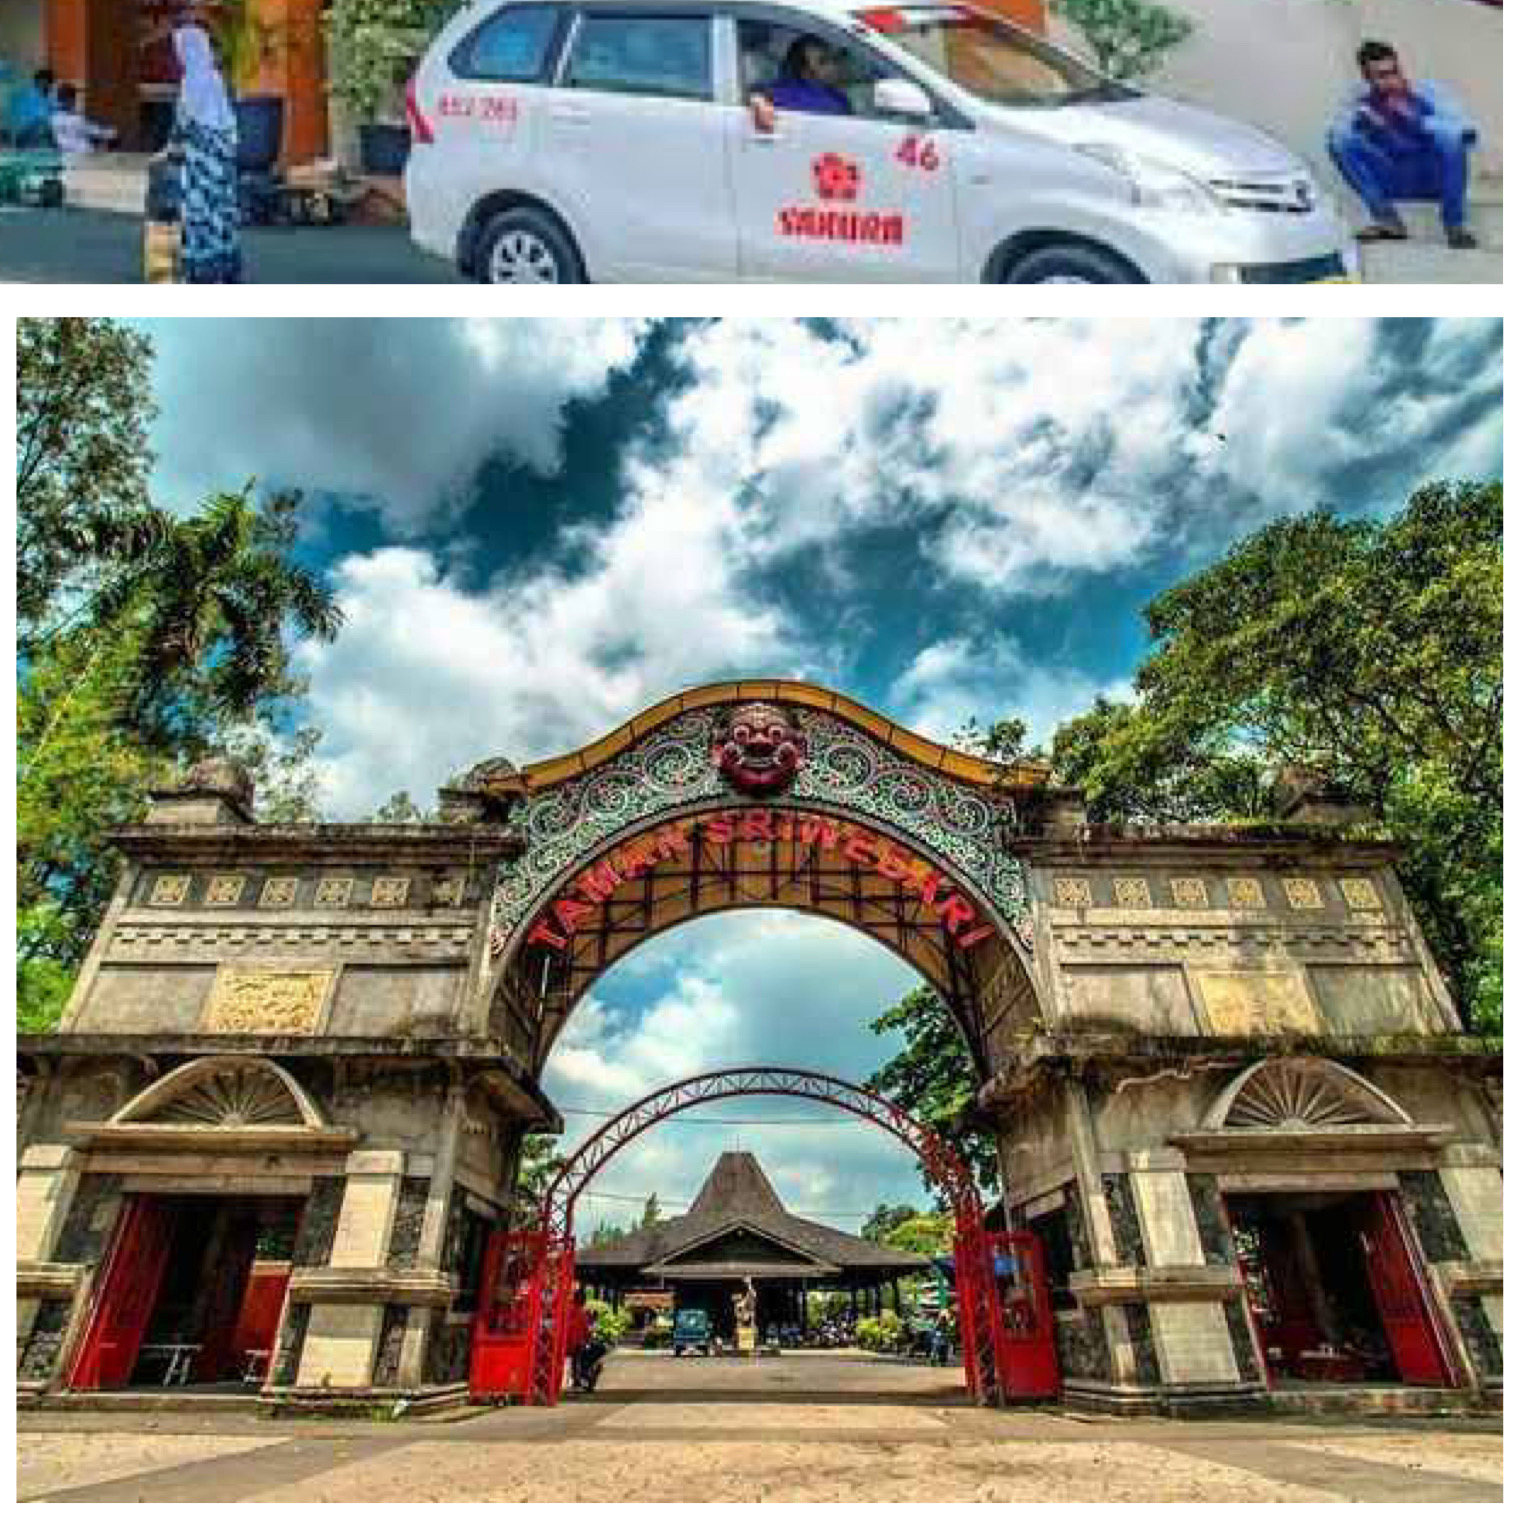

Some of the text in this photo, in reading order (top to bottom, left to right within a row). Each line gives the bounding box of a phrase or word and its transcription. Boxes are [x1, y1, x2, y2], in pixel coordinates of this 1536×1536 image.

[895, 136, 940, 172] 46
[776, 207, 904, 246] SAKURA
[526, 806, 996, 950] TAMAN SRIWEDARI
